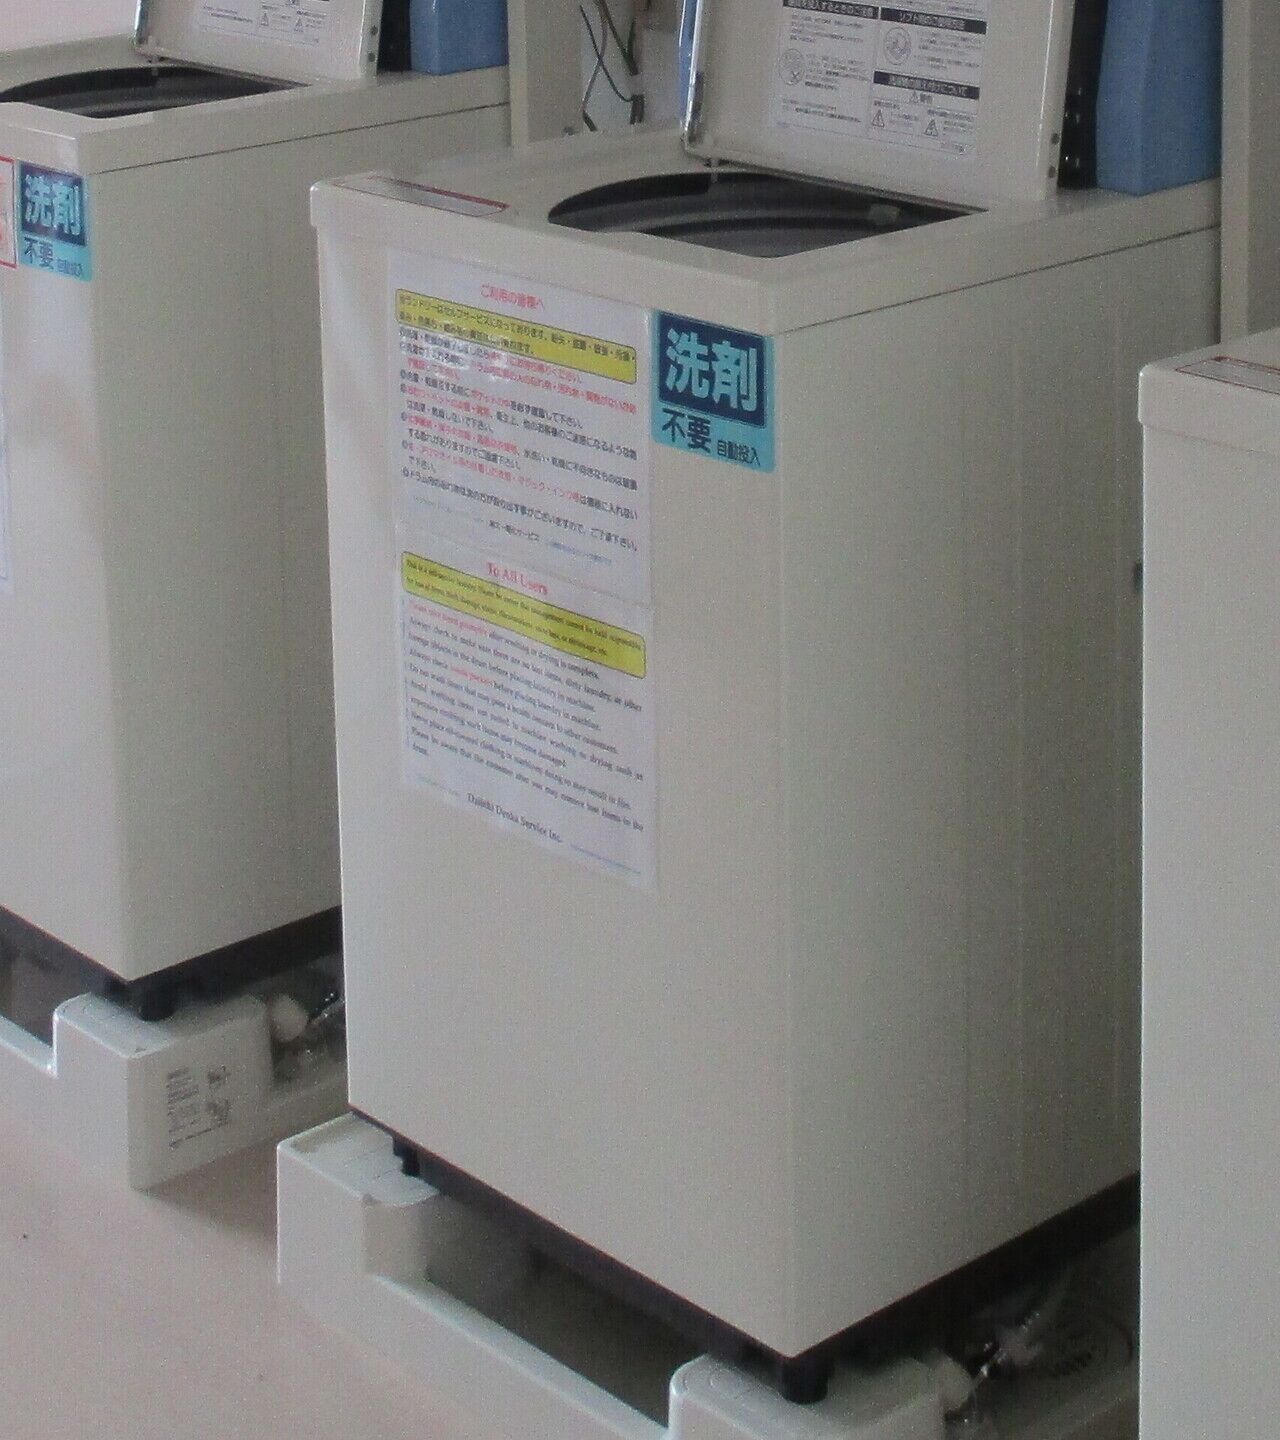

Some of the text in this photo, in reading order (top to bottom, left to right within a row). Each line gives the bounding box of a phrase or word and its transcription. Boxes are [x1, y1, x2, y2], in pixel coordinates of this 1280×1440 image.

[24, 173, 83, 237] 洗剤
[23, 236, 55, 271] 不要
[665, 327, 758, 412] 洗剤
[661, 407, 762, 467] 不要 自動投入
